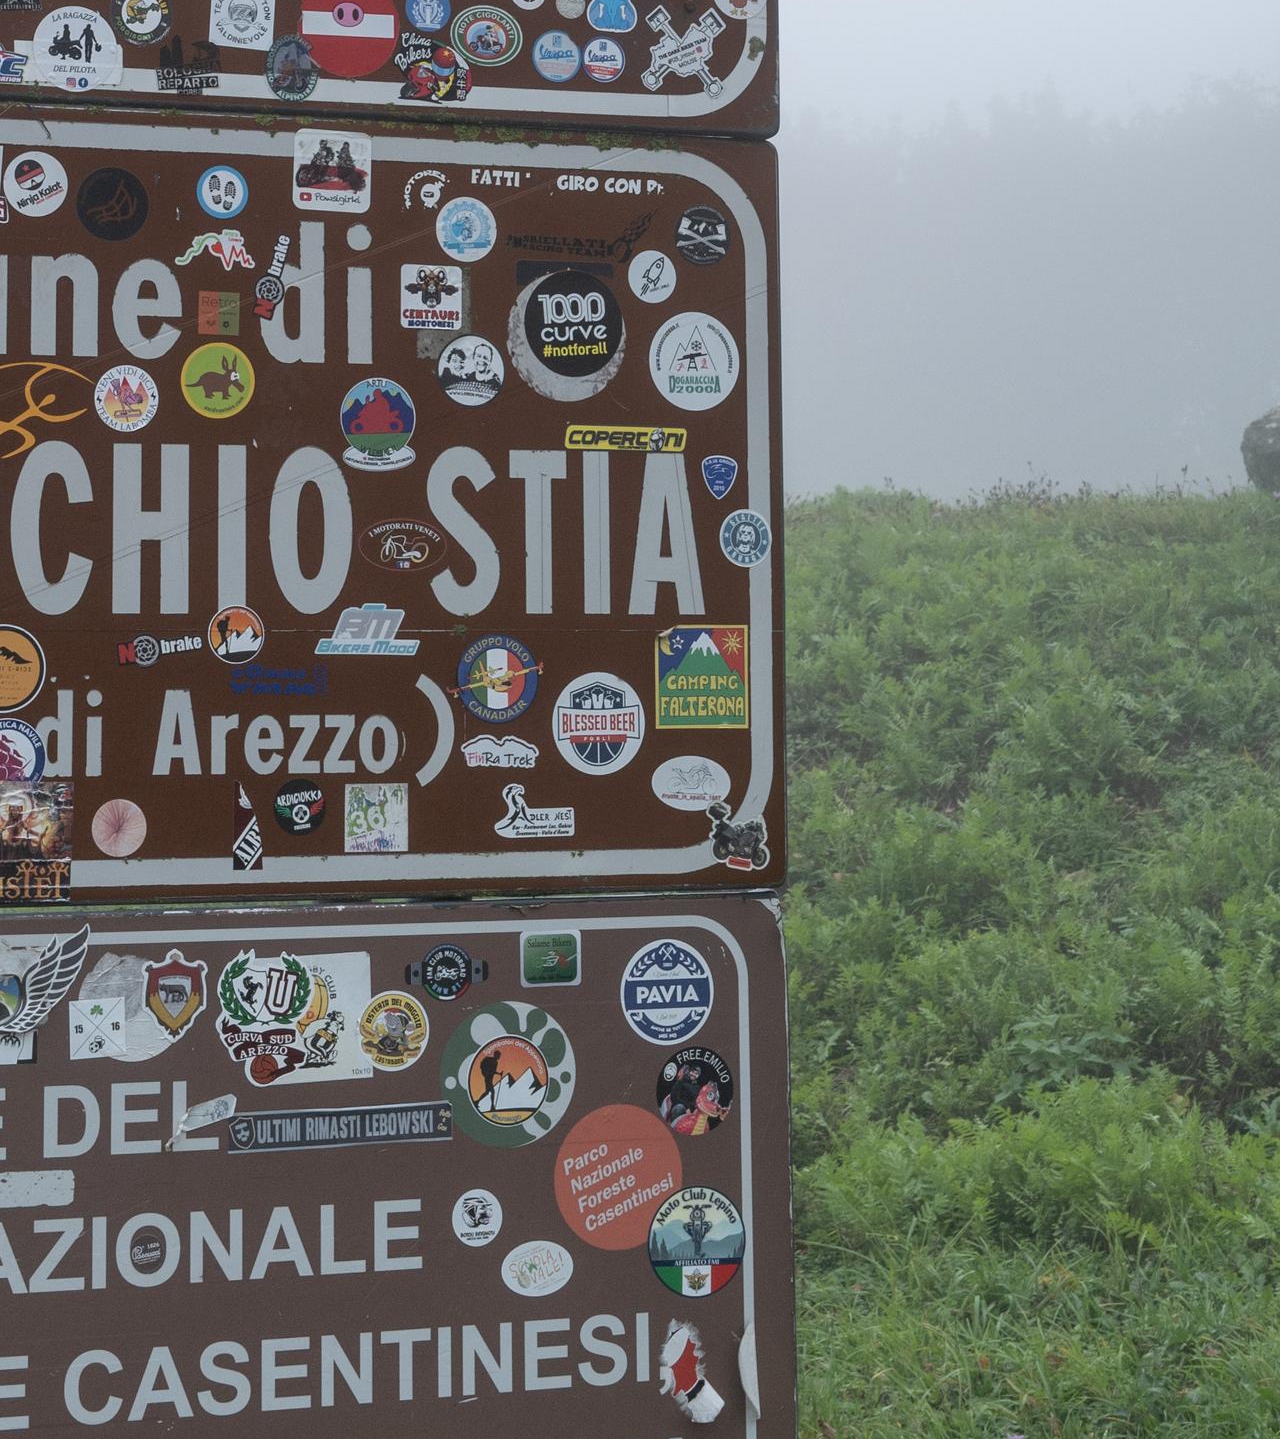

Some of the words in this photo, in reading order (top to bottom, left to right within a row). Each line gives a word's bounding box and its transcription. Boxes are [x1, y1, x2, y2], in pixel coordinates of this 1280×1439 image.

[401, 32, 432, 47] China
[394, 47, 432, 71] Bikers
[472, 168, 520, 188] FATTI
[556, 174, 599, 193] GIRO
[604, 176, 641, 195] CON
[267, 234, 292, 278] brake
[259, 221, 373, 365] di
[540, 324, 608, 343] curve
[543, 340, 608, 358] #notforall
[427, 445, 706, 617] STIA
[160, 635, 203, 656] brake
[464, 636, 503, 664] GRUPPO
[505, 636, 530, 663] VOLO
[666, 674, 739, 691] CAMPING
[469, 698, 527, 723] CANADAIR
[660, 695, 745, 717] FALTERONA
[18, 721, 42, 750] NAVILE
[40, 689, 103, 778] di
[152, 673, 456, 788] Arezzo)
[562, 712, 609, 733] BLESSED
[609, 713, 636, 733] BEER
[635, 983, 700, 1007] PAVIA
[227, 1032, 264, 1046] CURVA
[269, 1032, 294, 1046] SUD
[239, 1046, 289, 1060] AREZZO
[43, 1081, 219, 1159] DEL
[256, 1119, 302, 1145] ULTIMI
[305, 1115, 362, 1142] RIMASTI
[365, 1109, 434, 1138] LEBOWSKI
[563, 1143, 609, 1176] Parco
[570, 1145, 644, 1195] Nazionale
[577, 1172, 637, 1214] Foreste
[584, 1172, 675, 1233] Casentinesi
[656, 1195, 682, 1227] Moto
[681, 1186, 708, 1203] Club
[707, 1189, 738, 1226] Lepino
[63, 1312, 650, 1425] CASENTINESI
